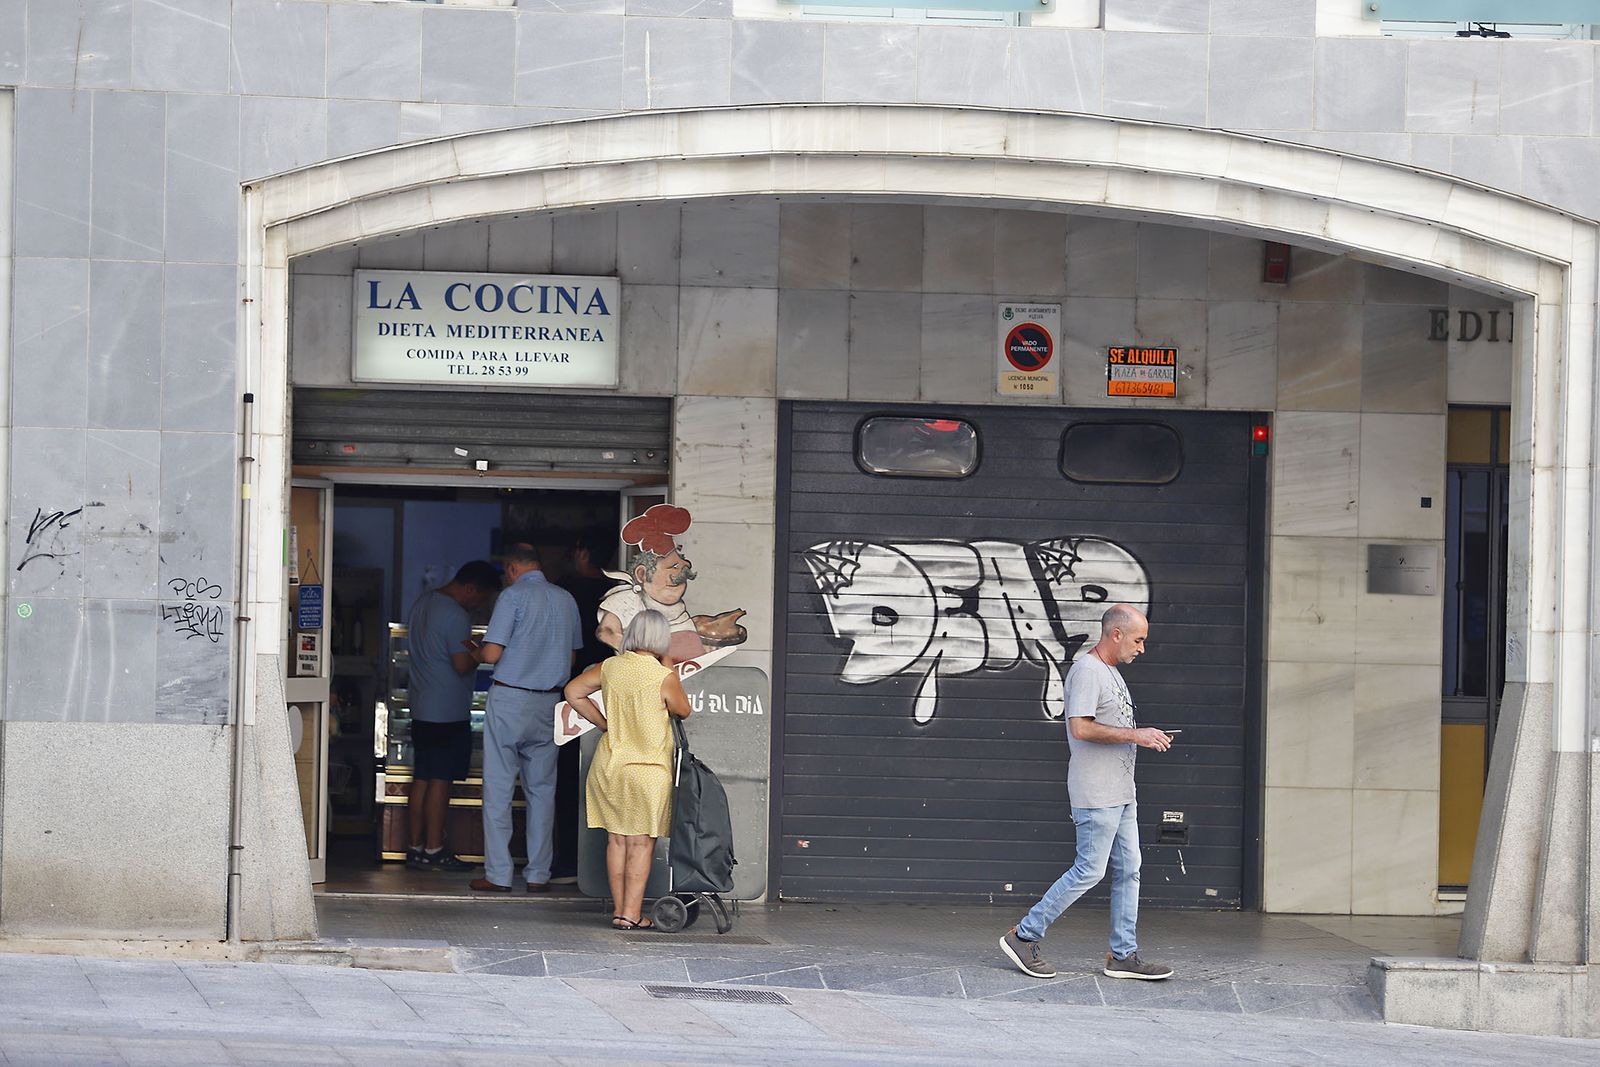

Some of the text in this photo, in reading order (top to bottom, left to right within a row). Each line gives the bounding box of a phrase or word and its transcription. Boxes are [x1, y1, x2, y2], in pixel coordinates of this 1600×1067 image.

[366, 280, 611, 316] LA COCINA
[378, 322, 604, 342] DIETA MEDITERRANEA
[1427, 309, 1514, 343] EDI
[406, 348, 570, 364] COMIDA PARA LLEVAR
[1010, 345, 1048, 353] PERMANENTE
[1109, 348, 1175, 365] SE ALQUILA
[447, 364, 529, 377] TEL. 28 53 99
